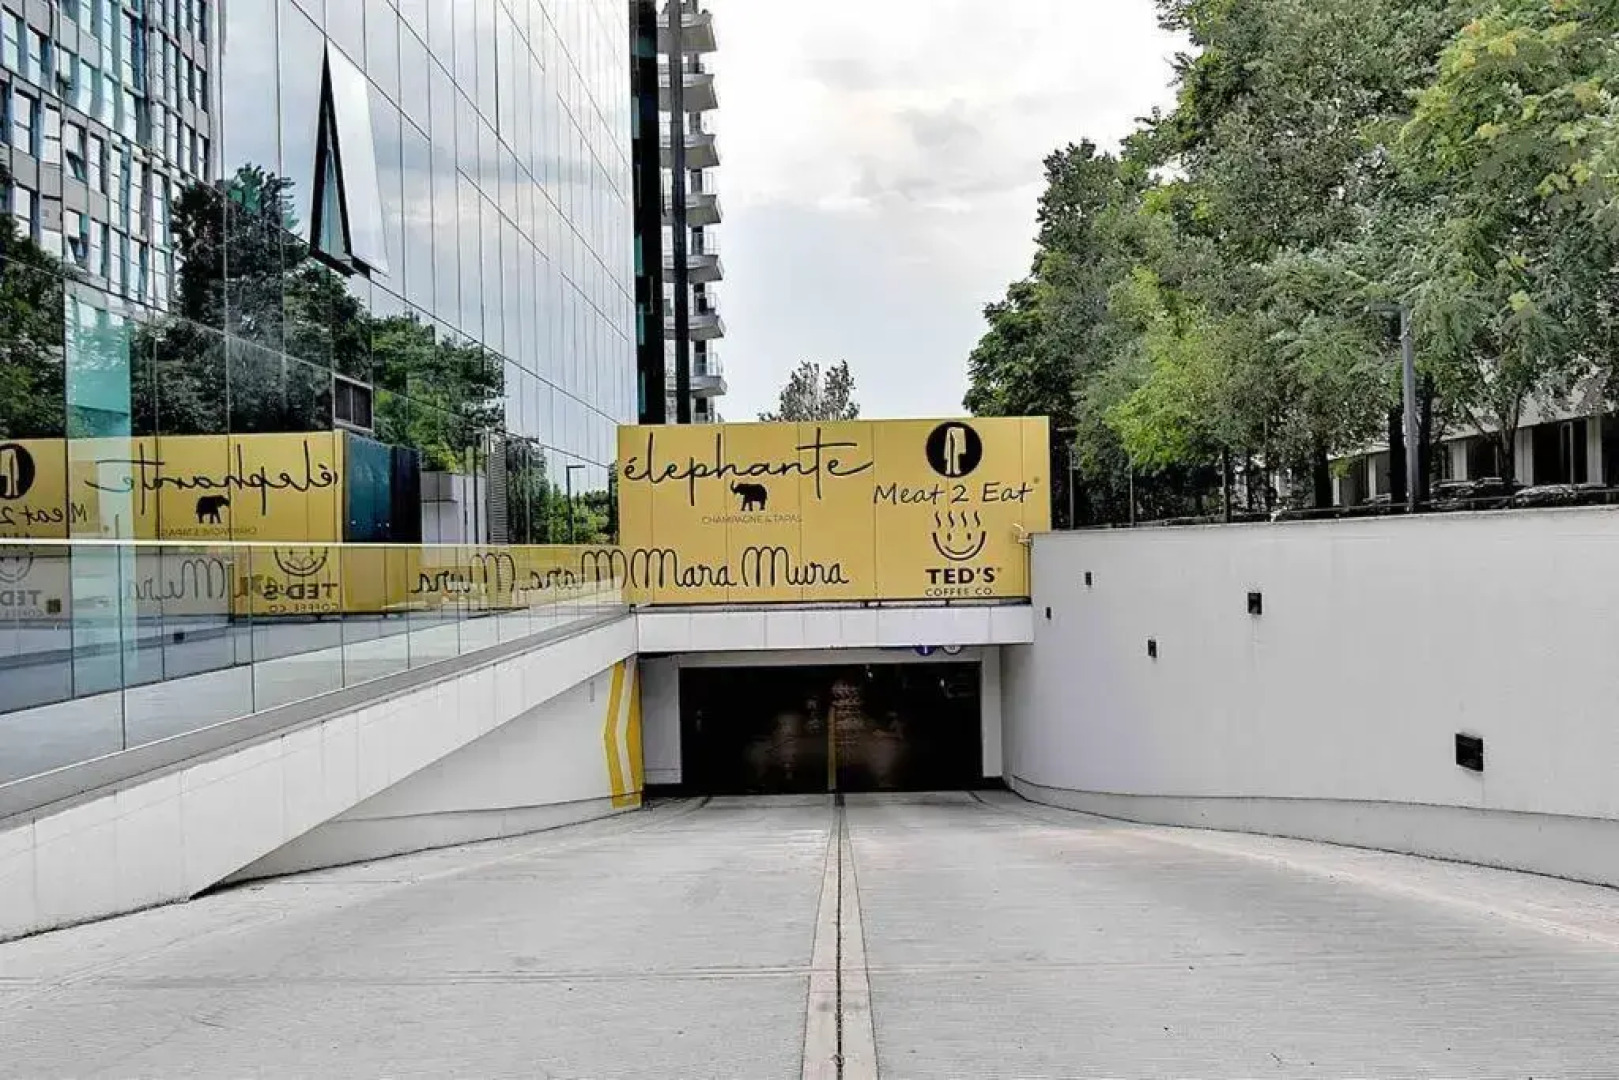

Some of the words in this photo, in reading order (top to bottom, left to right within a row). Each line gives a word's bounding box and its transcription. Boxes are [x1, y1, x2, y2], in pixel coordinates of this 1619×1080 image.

[623, 427, 873, 506] élephante
[873, 482, 945, 505] Meat
[951, 485, 969, 504] 2
[982, 481, 1033, 503] Eat
[630, 548, 737, 588] Mara
[742, 546, 849, 587] Mura
[925, 567, 995, 585] TED'S
[924, 588, 970, 597] COFFEE
